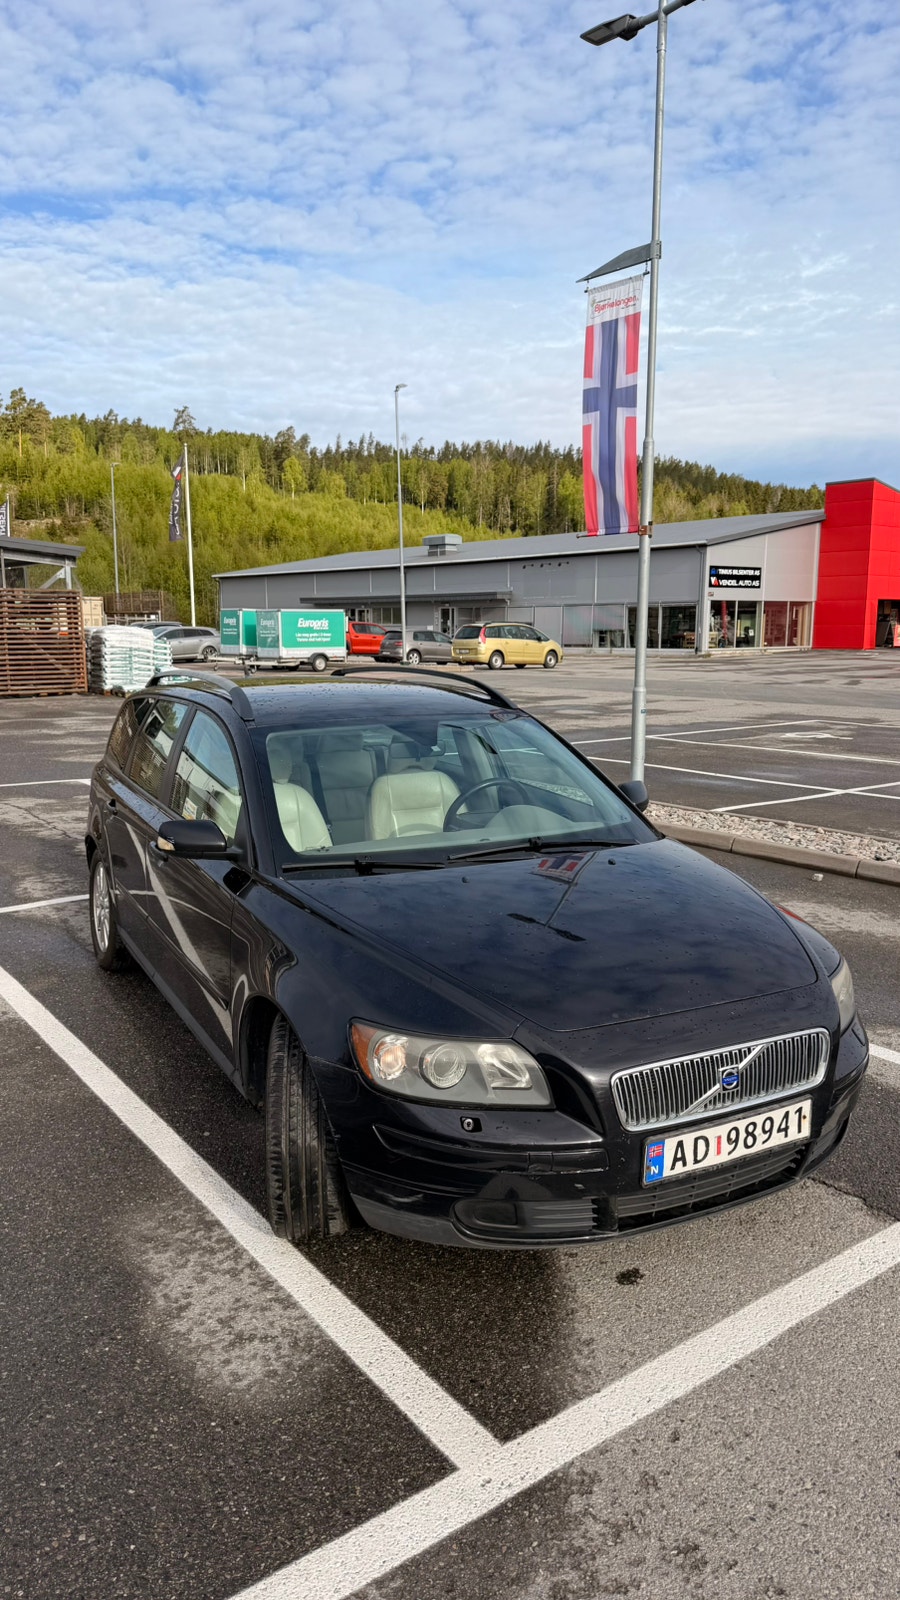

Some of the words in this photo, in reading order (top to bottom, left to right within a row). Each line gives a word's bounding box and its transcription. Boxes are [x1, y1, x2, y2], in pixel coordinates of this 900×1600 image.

[298, 617, 329, 629] Europris
[651, 1165, 659, 1175] N
[670, 1135, 710, 1171] AD
[726, 1106, 803, 1156] 98941
